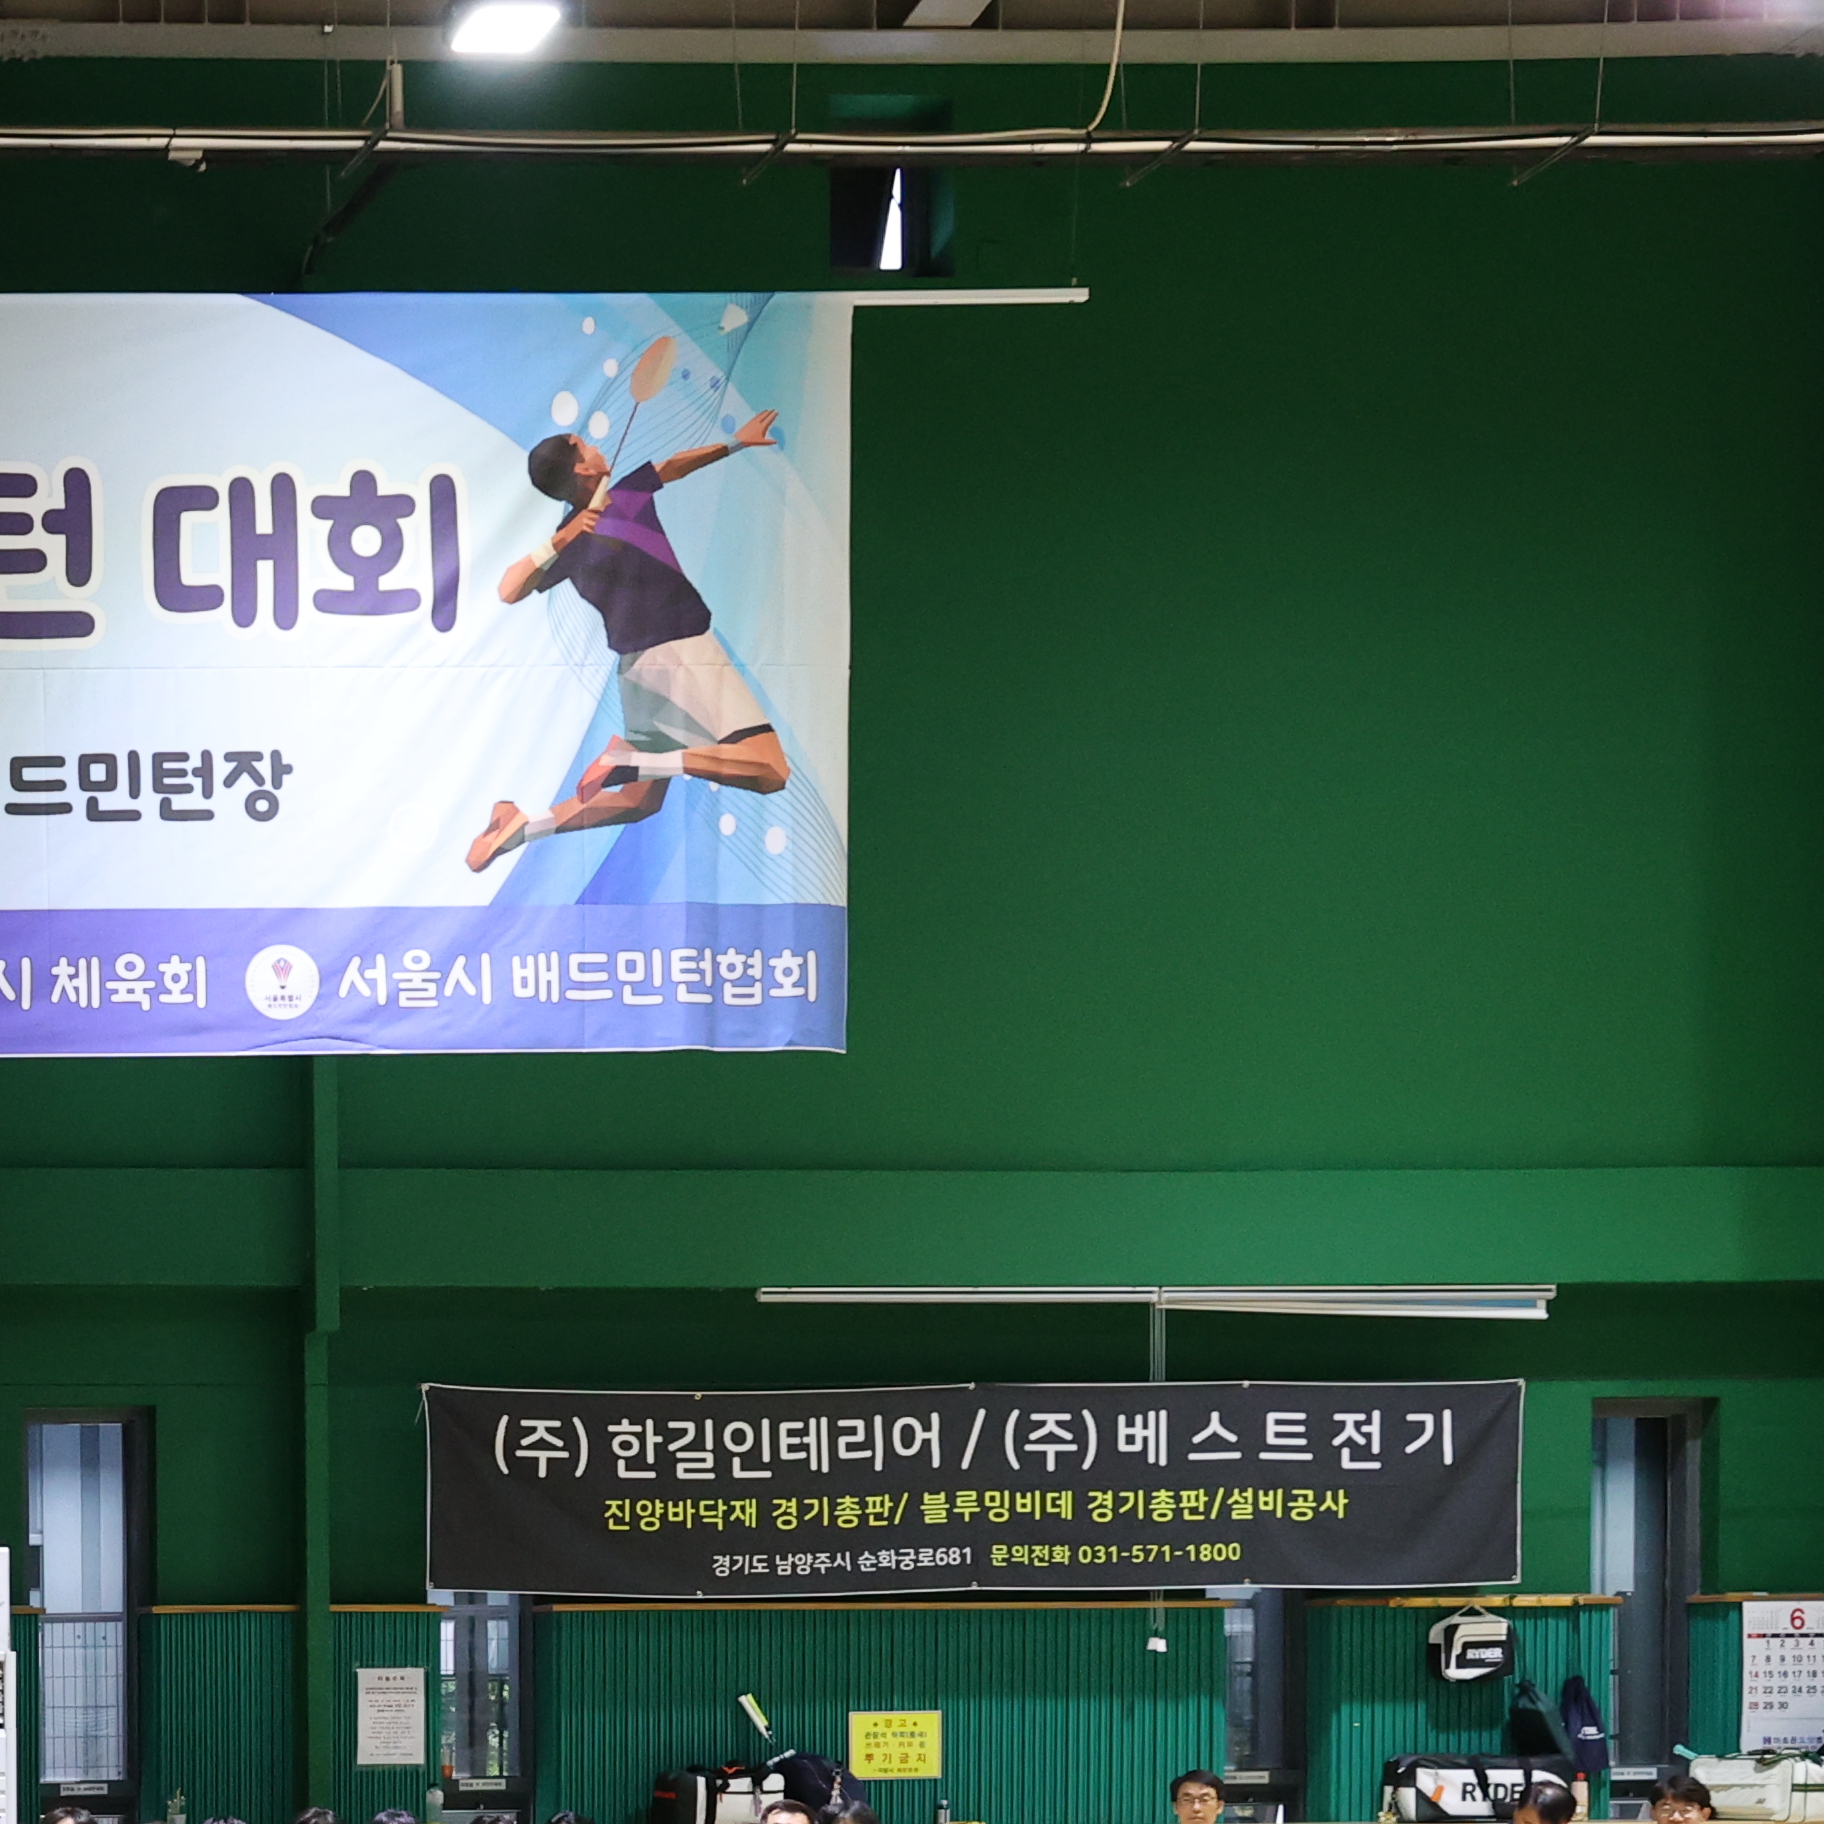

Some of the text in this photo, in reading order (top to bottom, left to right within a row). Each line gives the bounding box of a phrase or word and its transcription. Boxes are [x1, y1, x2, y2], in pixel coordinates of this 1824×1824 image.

[152, 472, 459, 635] 대회
[51, 953, 207, 1011] 체육회
[337, 947, 816, 1009] 서울시 배드민턴협회
[495, 1414, 589, 1478] (주)
[607, 1412, 940, 1480] 한길인테리어
[1004, 1408, 1097, 1472] (주)
[604, 1486, 1350, 1532] 진양바닥재 경기총판/ 블루밍비데 경기총판/설비공사
[712, 1542, 1242, 1577] 경기도 남양주시 순화궁로681 문의전화 031-571-1800
[1790, 1608, 1806, 1630] 6
[1466, 1647, 1504, 1660] RYDER
[1461, 1782, 1525, 1803] RDE
